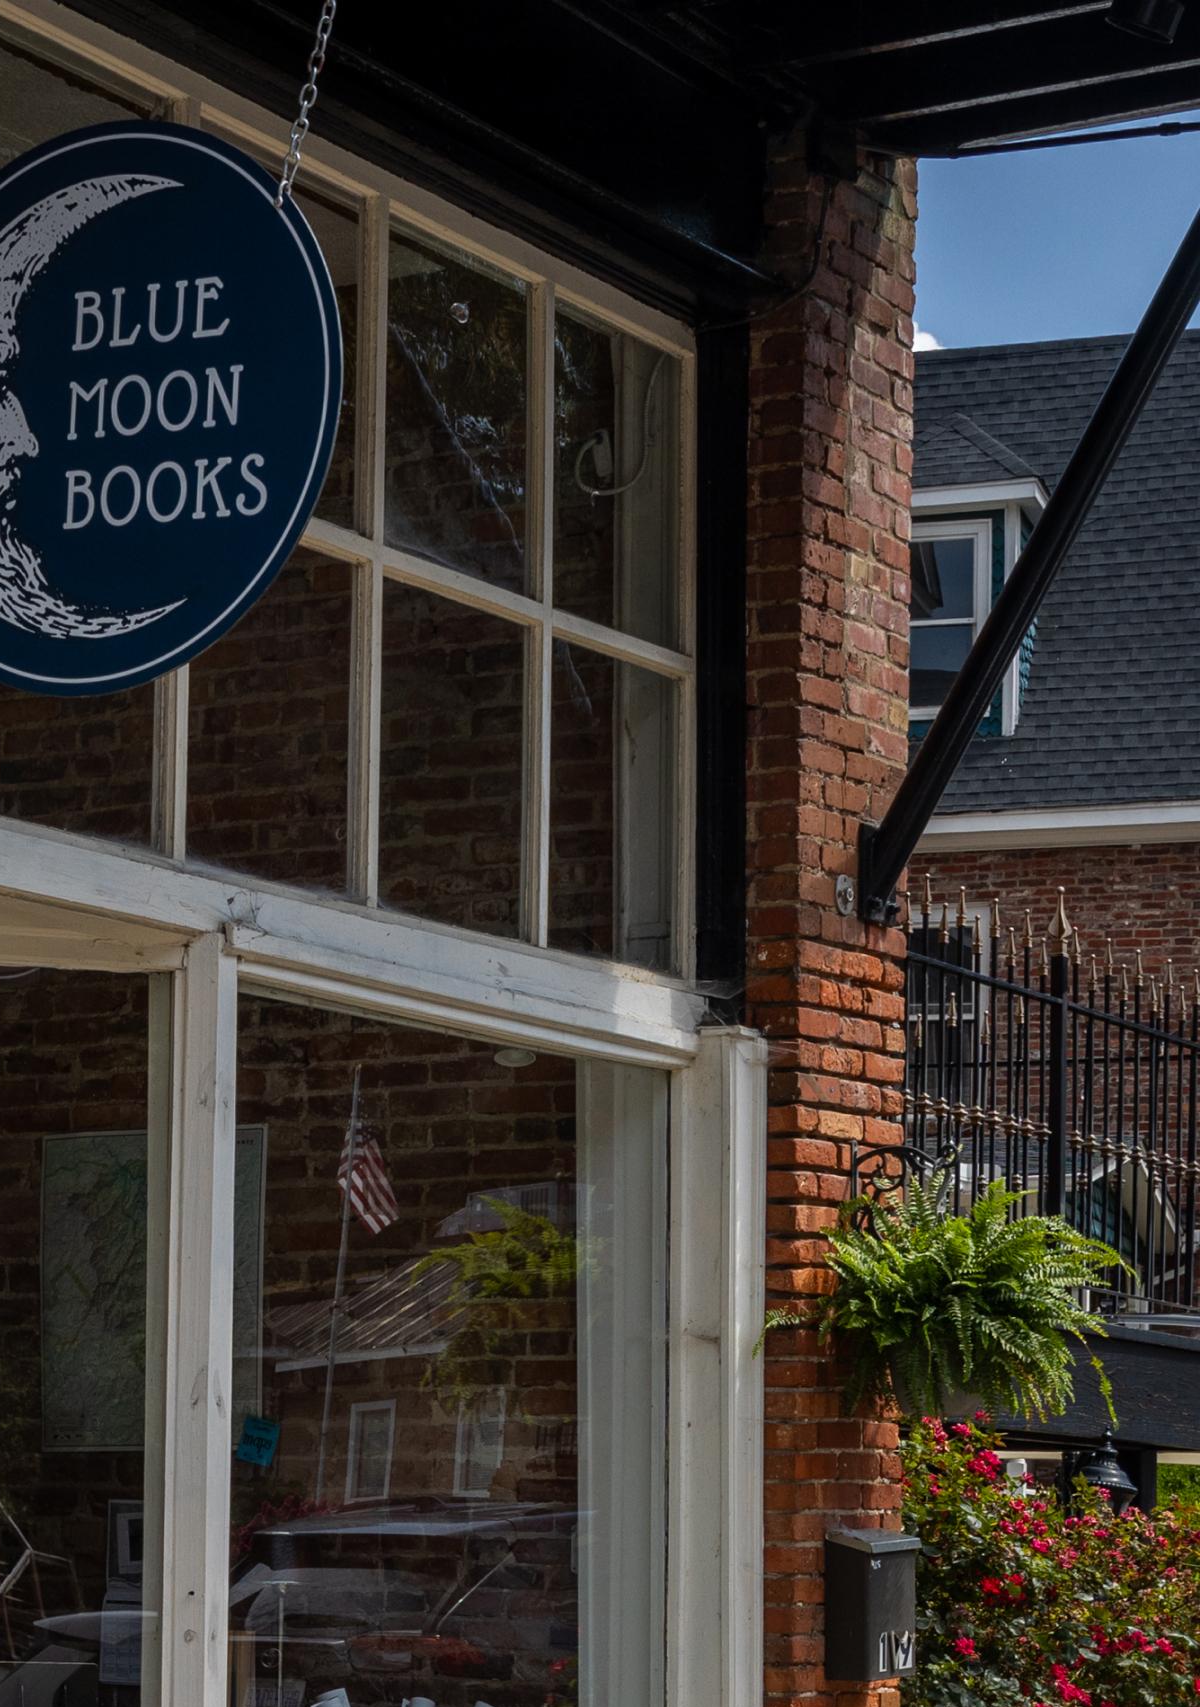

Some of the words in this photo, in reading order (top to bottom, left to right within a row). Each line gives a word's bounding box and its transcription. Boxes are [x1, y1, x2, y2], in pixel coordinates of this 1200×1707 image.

[71, 275, 231, 351] BLUE
[67, 364, 244, 440] MOON
[62, 453, 268, 530] BOOKS
